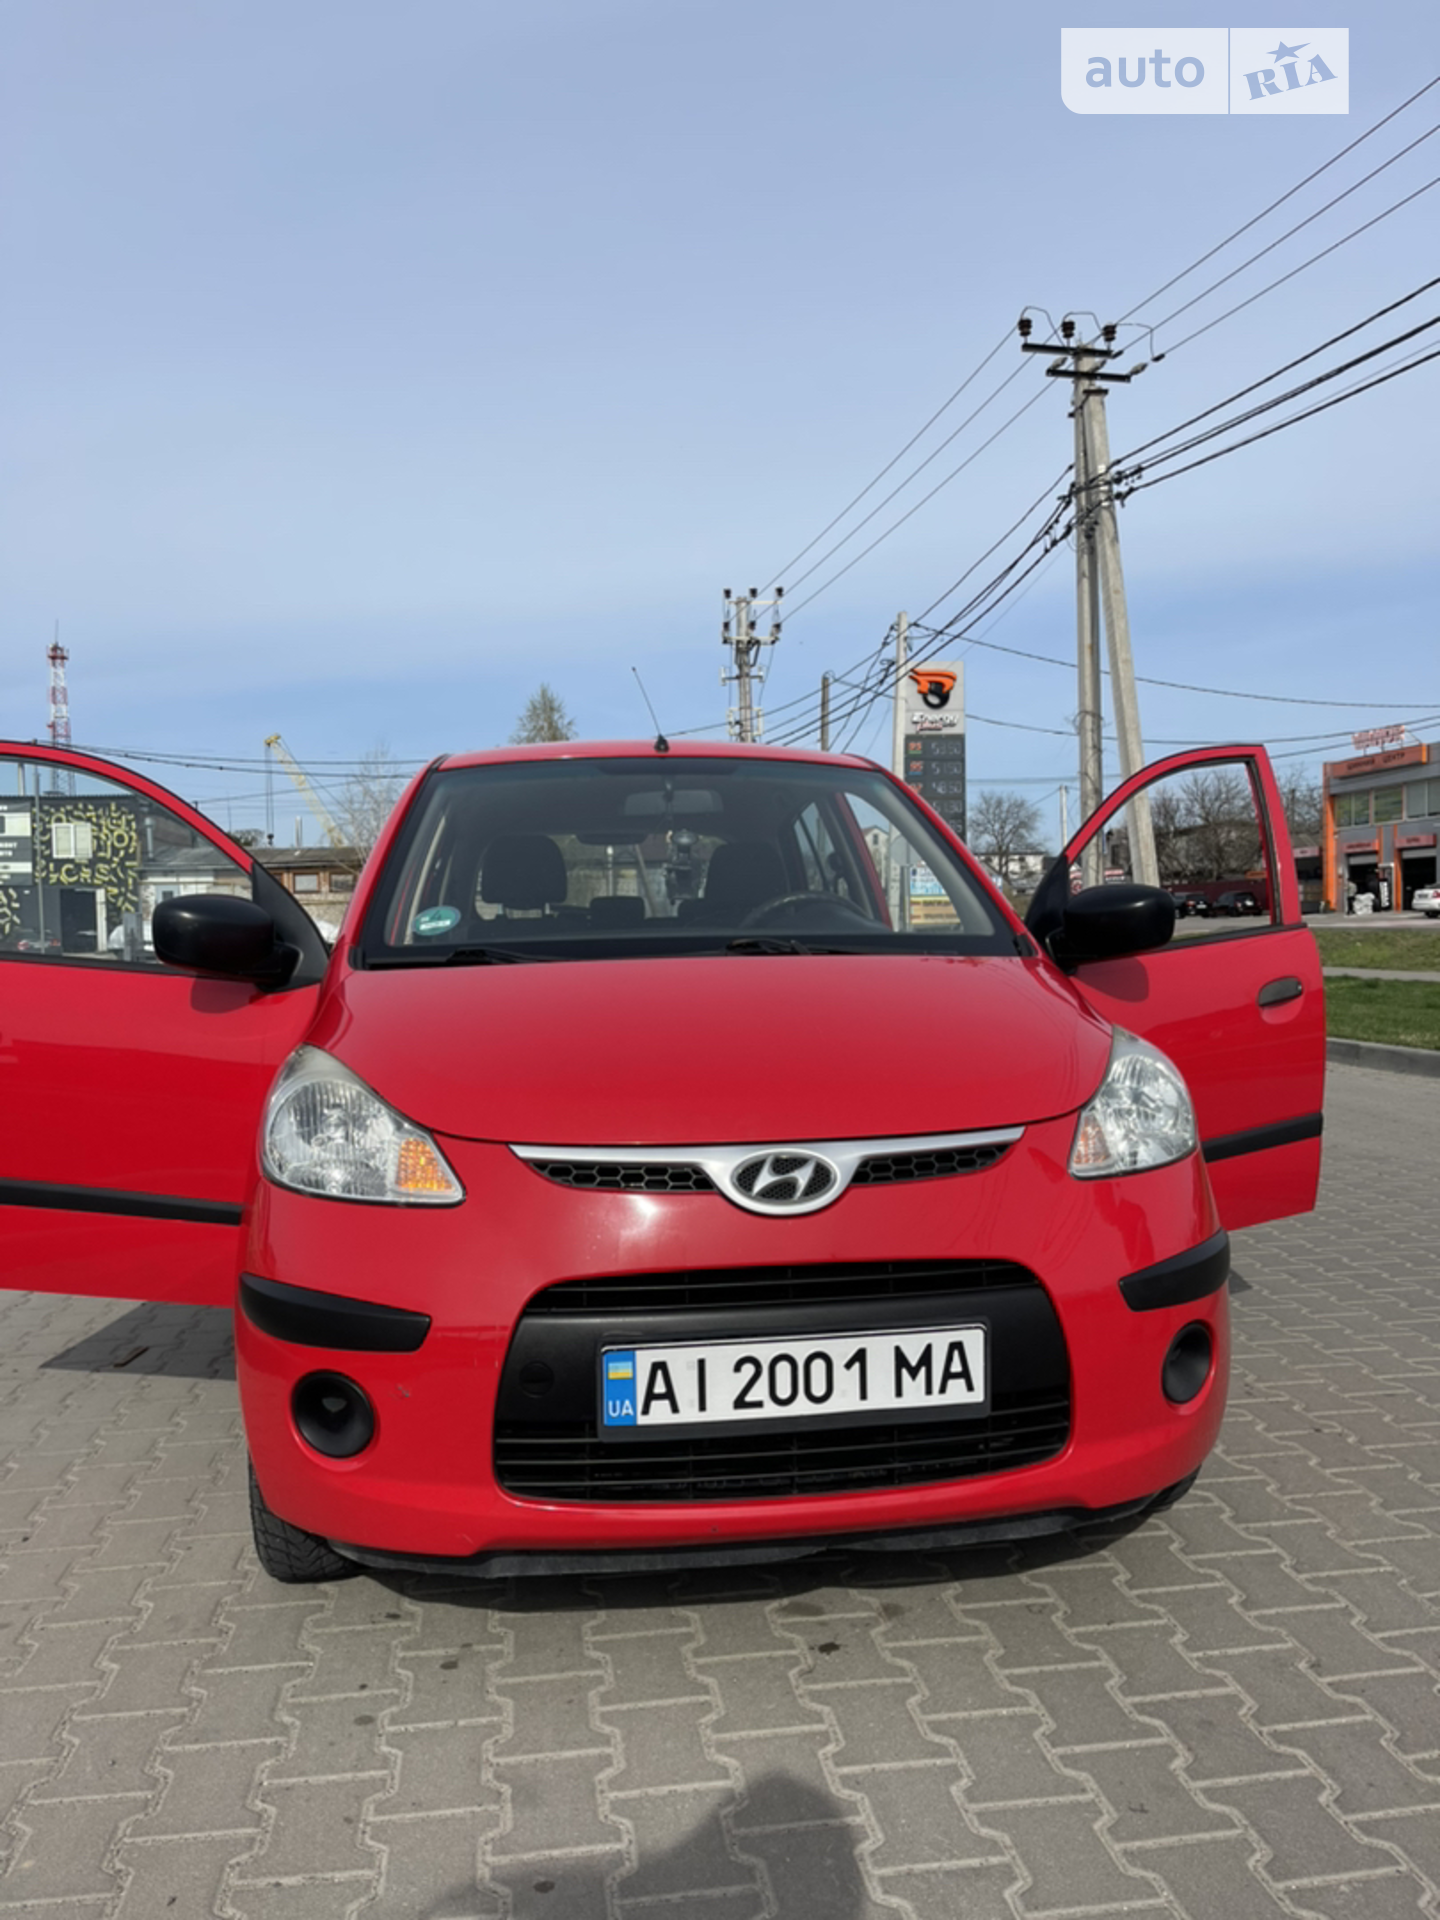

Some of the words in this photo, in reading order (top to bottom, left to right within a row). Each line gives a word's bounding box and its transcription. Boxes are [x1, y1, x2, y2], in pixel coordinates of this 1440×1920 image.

[641, 1358, 707, 1416] AI
[732, 1347, 869, 1411] 2001
[893, 1340, 975, 1398] MA
[607, 1400, 635, 1418] UA
